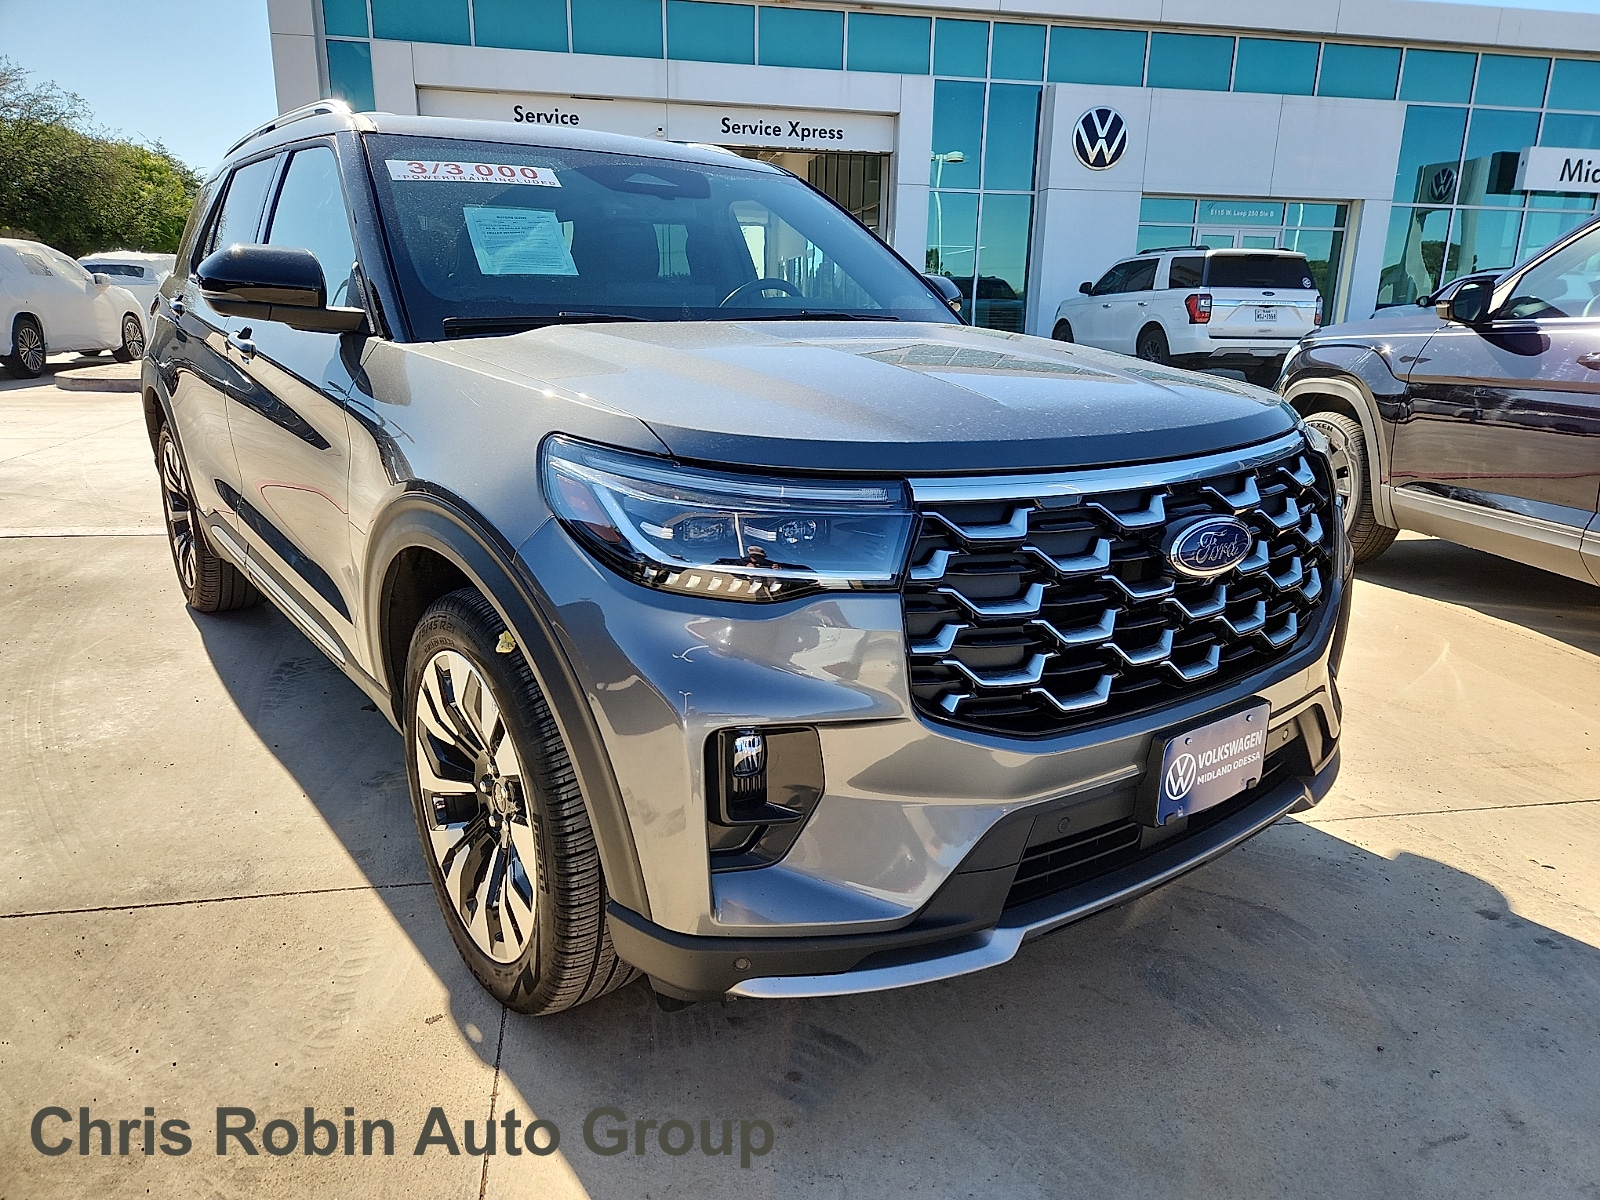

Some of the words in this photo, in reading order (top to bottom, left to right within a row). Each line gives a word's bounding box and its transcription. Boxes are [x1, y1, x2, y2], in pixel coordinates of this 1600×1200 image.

[513, 105, 580, 126] Service
[721, 117, 783, 137] Service
[787, 121, 844, 141] Xpress
[1073, 106, 1128, 170] VW
[494, 178, 556, 186] INCLUDED
[1307, 422, 1333, 432] EXEN
[1196, 529, 1239, 564] Ford
[1198, 730, 1263, 769] VOLKSWAGEN
[1197, 764, 1232, 785] MIDLAND
[1233, 752, 1261, 770] ODESSA
